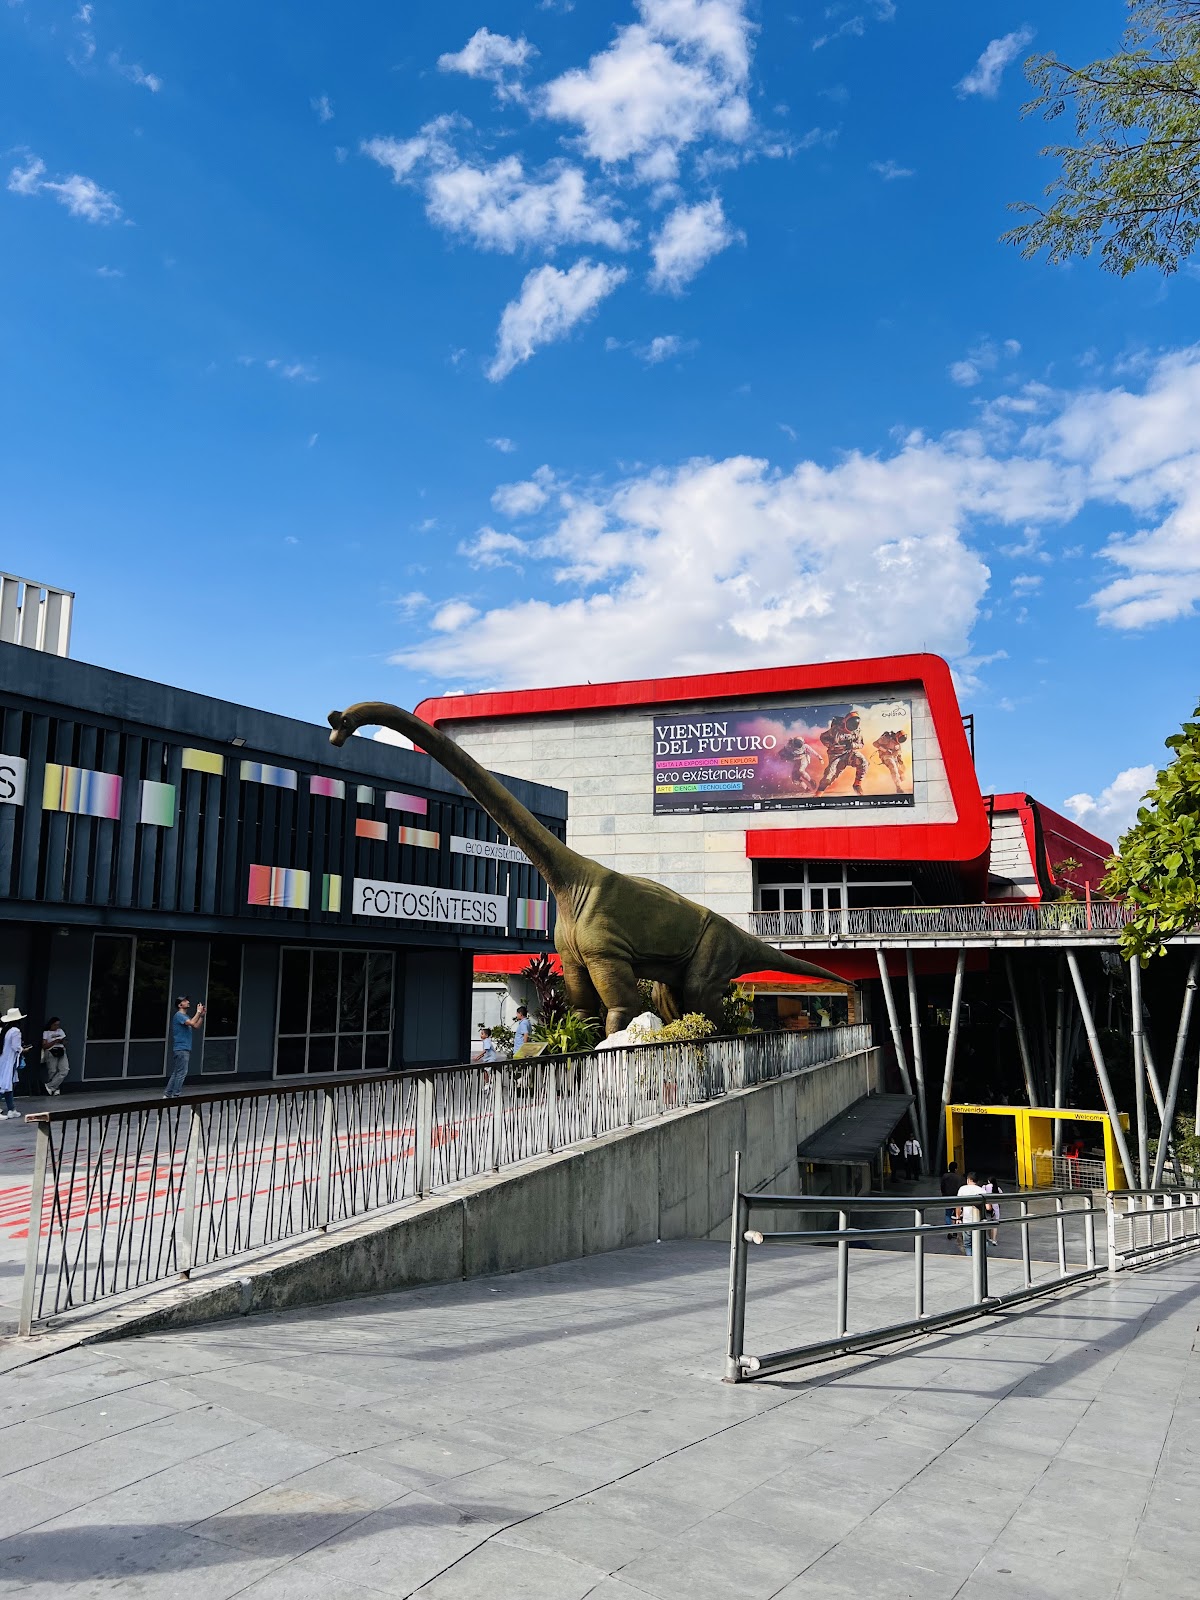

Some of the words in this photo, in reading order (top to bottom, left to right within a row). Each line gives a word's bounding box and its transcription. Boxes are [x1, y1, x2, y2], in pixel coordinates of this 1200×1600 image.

[656, 722, 728, 740] VIENEN
[656, 740, 693, 756] DEL
[698, 735, 777, 753] FUTURO
[656, 772, 679, 783] eco
[682, 766, 755, 782] existencias
[699, 782, 741, 791] TECNOLOGÍAS
[465, 842, 483, 855] eco
[362, 886, 497, 923] FOTOSÍNTESIS
[951, 1106, 988, 1114] Bienvenidos
[1074, 1113, 1104, 1121] Welcome
